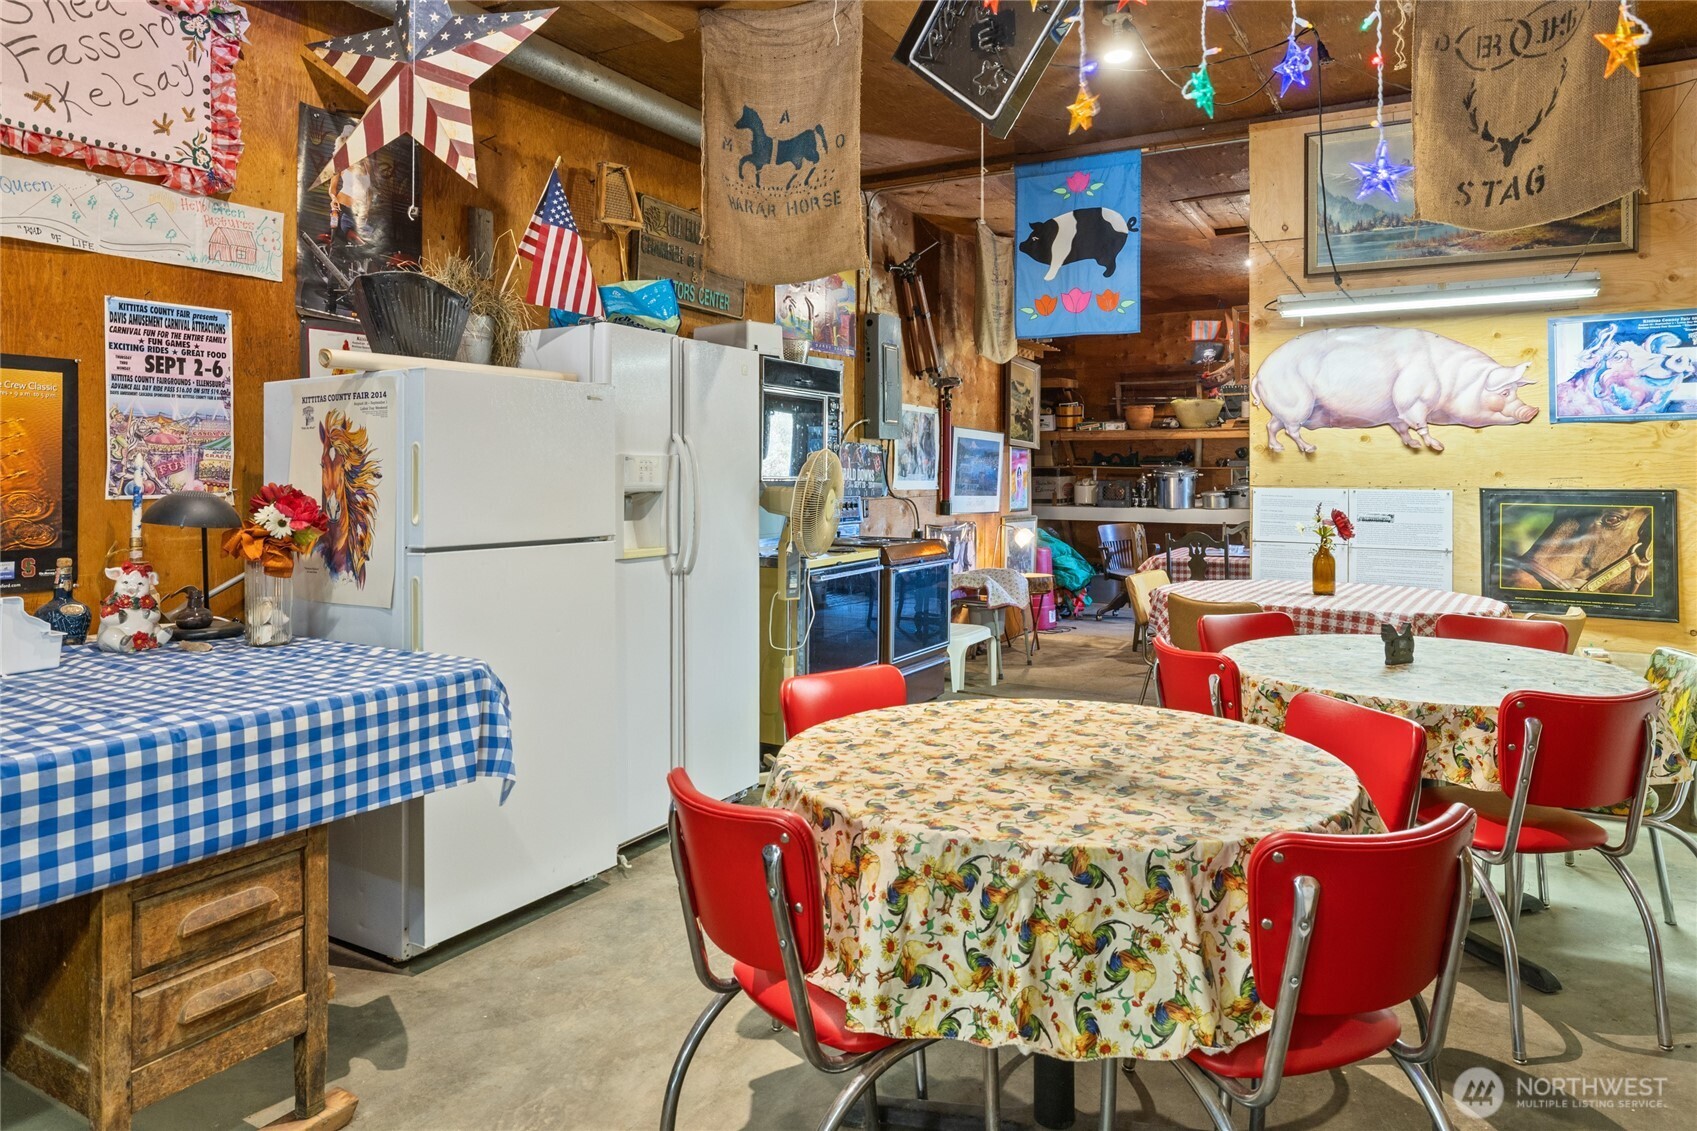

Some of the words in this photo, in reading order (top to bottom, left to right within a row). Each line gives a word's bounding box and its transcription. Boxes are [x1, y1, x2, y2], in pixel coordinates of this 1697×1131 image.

[0, 15, 175, 83] Fassero
[45, 60, 195, 123] Kelsay
[779, 110, 790, 124] A
[0, 176, 52, 193] Queen
[1454, 165, 1545, 207] STAG
[211, 202, 246, 218] Green
[787, 190, 841, 217] HORSE
[204, 215, 255, 230] Pastures
[72, 238, 95, 250] LIFE
[692, 271, 698, 284] &
[673, 280, 695, 302] TORS
[698, 287, 730, 311] CENTER
[119, 302, 148, 313] KITTITAS
[150, 306, 174, 316] COUNTY
[176, 310, 190, 318] FAIR
[192, 312, 218, 322] presents
[110, 311, 126, 324] DAVIS
[128, 314, 164, 328] AMUSEMENT
[164, 318, 190, 332] CARNIVAL
[192, 320, 226, 334] ATTRACTIONS
[109, 326, 141, 336] CARNIVAL
[143, 329, 156, 337] FUN
[184, 334, 204, 342] ENTIRE
[206, 335, 227, 344] FAMILY
[166, 339, 190, 348] GAMES
[109, 342, 144, 352] EXCITING
[148, 346, 169, 354] RIDES
[181, 348, 204, 358] GREAT
[207, 351, 226, 359] FOOD
[144, 354, 186, 375] SEPT
[194, 358, 224, 378] 2-6
[4, 380, 26, 390] Crew
[28, 382, 58, 391] Classic
[111, 374, 133, 382] KITTITAS
[134, 375, 155, 384] COUNTY
[156, 376, 192, 386] FAIRGROUNDS
[196, 380, 226, 388] ELLENSBURG
[302, 395, 326, 404] KITTITAS
[328, 393, 352, 402] COUNTY
[353, 392, 369, 400] FAIR
[857, 468, 874, 481] DOWNS
